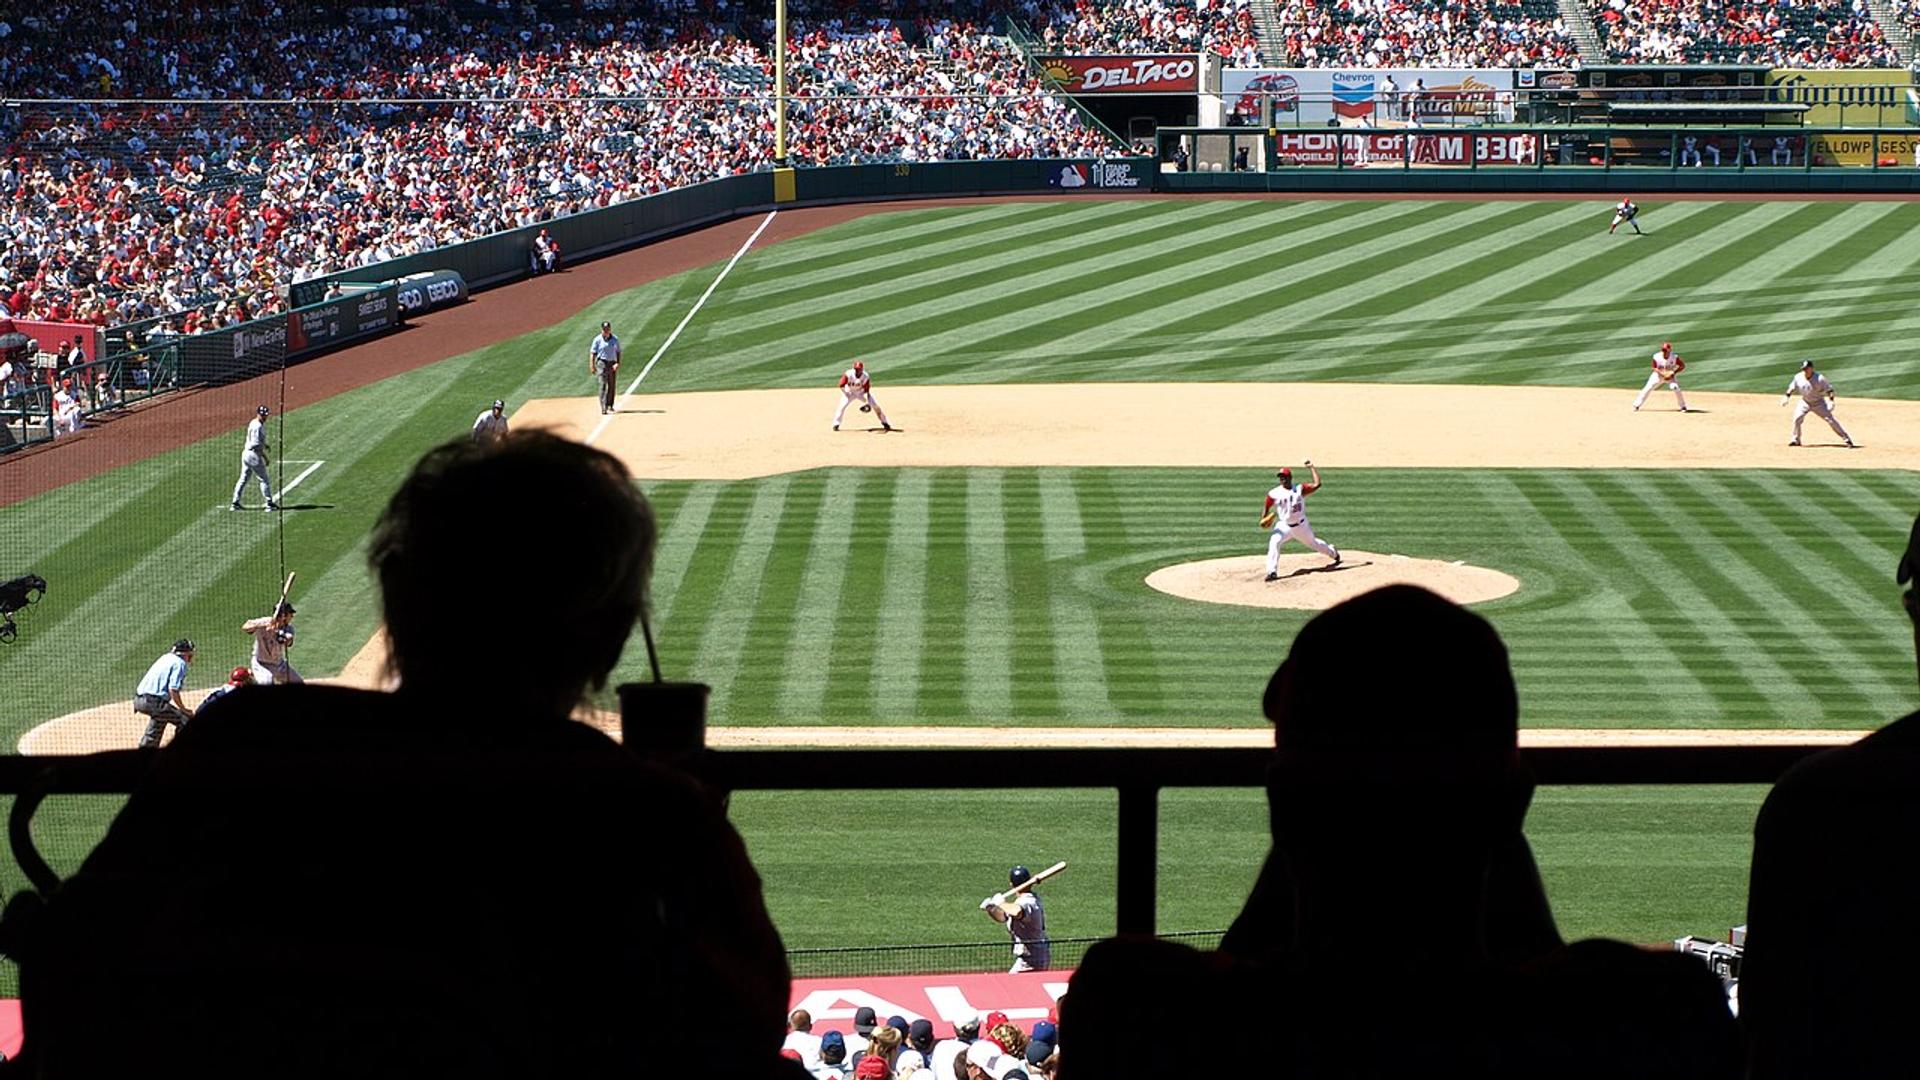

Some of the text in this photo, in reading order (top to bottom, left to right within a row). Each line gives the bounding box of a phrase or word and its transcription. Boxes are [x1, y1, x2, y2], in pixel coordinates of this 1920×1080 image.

[1332, 72, 1375, 82] Chevron
[1377, 134, 1403, 150] of
[1105, 163, 1131, 172] STAND
[1104, 177, 1138, 187] CANCER
[426, 280, 459, 303] GEICO
